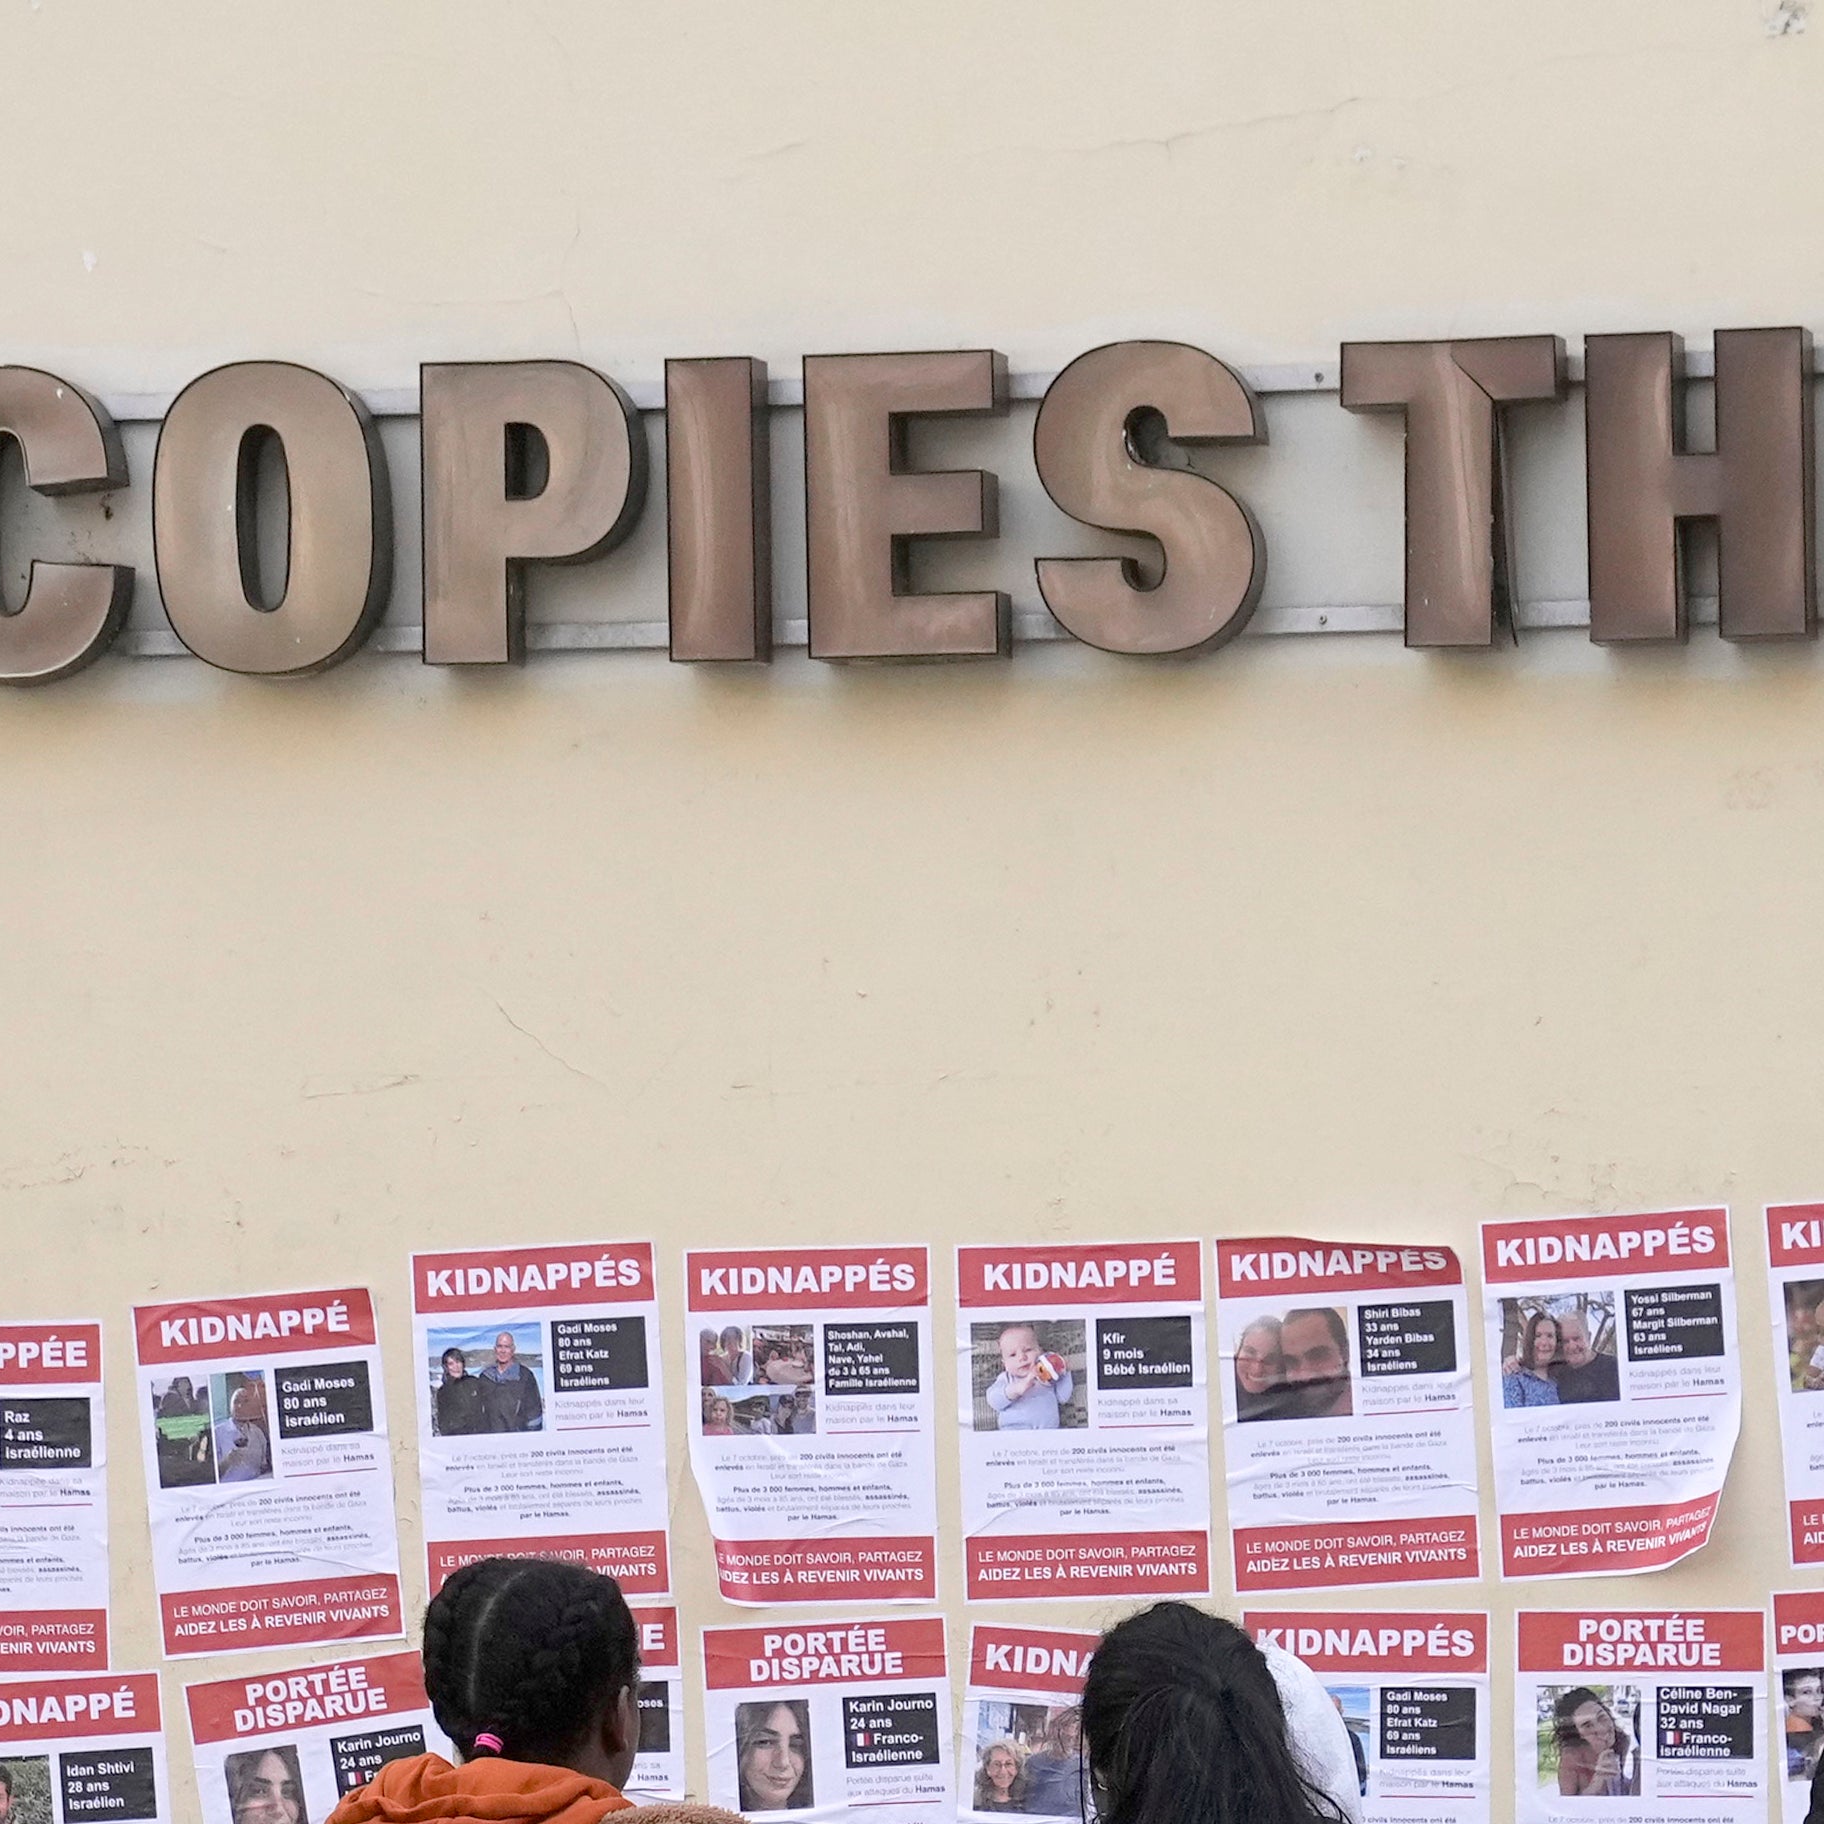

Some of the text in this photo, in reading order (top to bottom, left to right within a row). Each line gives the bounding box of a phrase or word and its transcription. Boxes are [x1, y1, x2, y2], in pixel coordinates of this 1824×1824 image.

[1497, 1221, 1715, 1266] KIDNAPPÉS
[427, 1254, 640, 1297] KIDNAPPÉS
[984, 1252, 1176, 1290] KIDNAPPÉ
[1231, 1250, 1446, 1281] KIDNAPPÉS
[701, 1258, 915, 1295] KIDNAPPÉS
[161, 1300, 350, 1346] KIDNAPPÉ
[1103, 1333, 1125, 1344] Kfir
[1103, 1348, 1144, 1360] 9 mois
[1104, 1364, 1135, 1375] Bébé
[32, 1624, 94, 1635] PARTAGEZ
[1579, 1614, 1706, 1641] PORTÉE
[36, 1640, 95, 1653] VIVANTS
[764, 1625, 887, 1655] PORTÉE
[1563, 1642, 1722, 1667] DISPARUE
[750, 1652, 904, 1682] DISPARUE
[246, 1666, 368, 1707] PORTÉE
[1660, 1686, 1738, 1700] Céline Ben-
[234, 1688, 388, 1733] DISPARUE
[850, 1699, 933, 1712] Karin Journo
[1660, 1701, 1742, 1717] David Nagar
[850, 1718, 892, 1729] 24 ans
[1660, 1717, 1704, 1729] 32 ans
[874, 1733, 923, 1744] Franco-
[1683, 1732, 1732, 1744] Franco-
